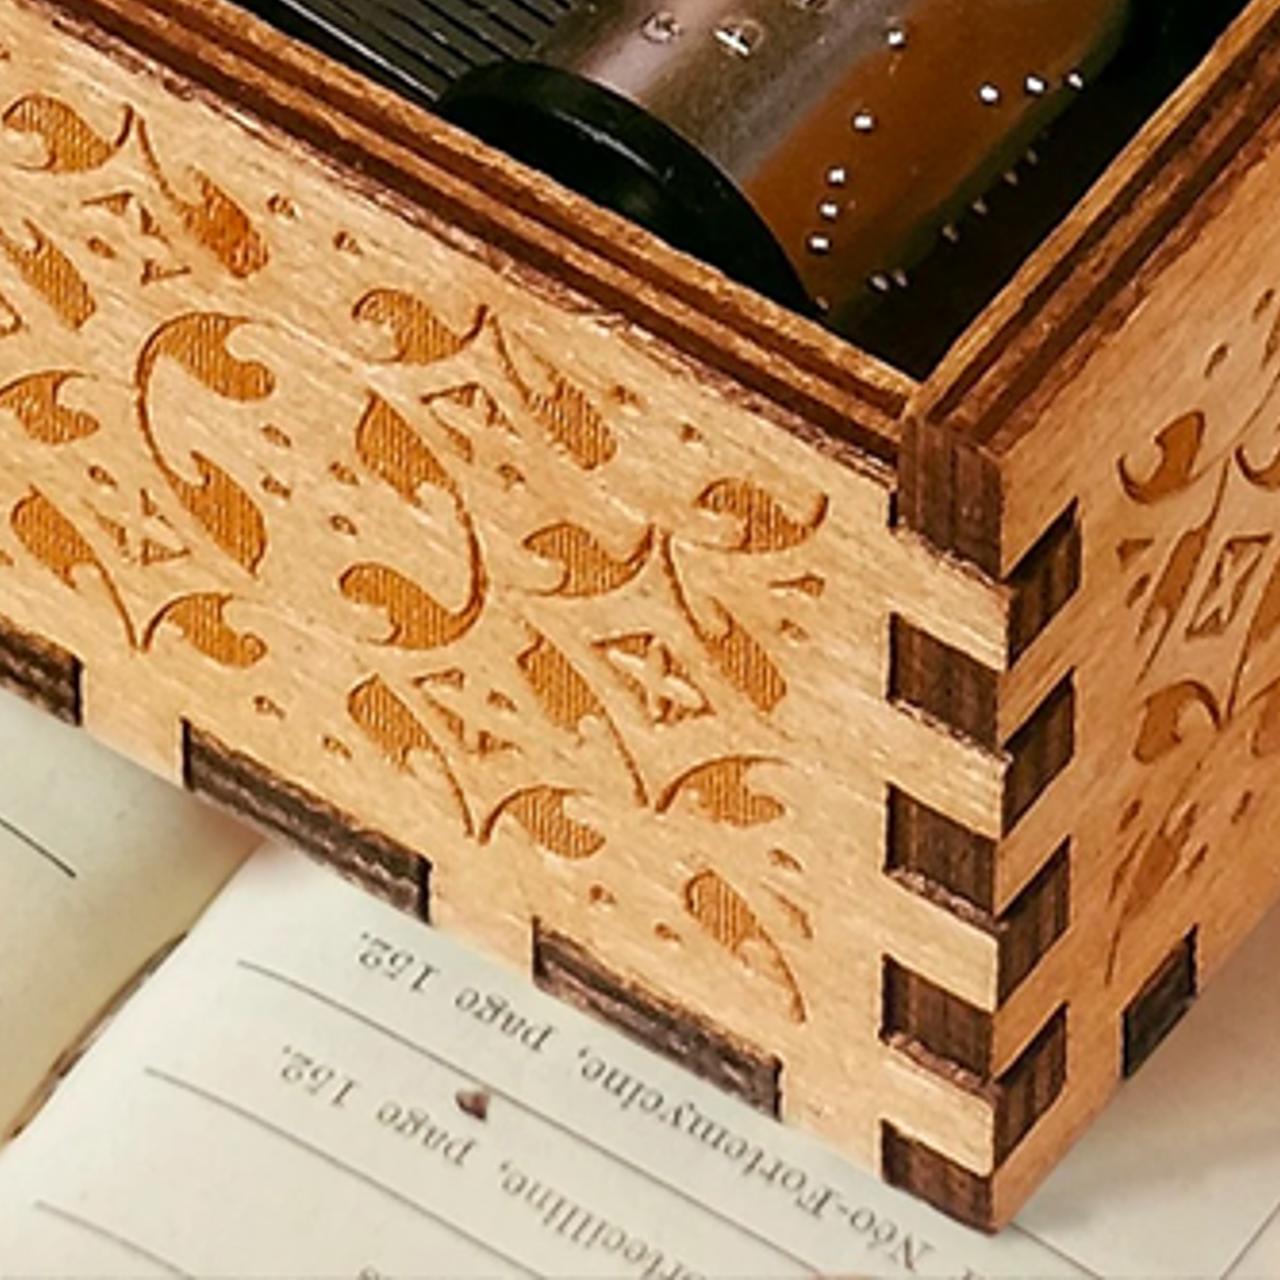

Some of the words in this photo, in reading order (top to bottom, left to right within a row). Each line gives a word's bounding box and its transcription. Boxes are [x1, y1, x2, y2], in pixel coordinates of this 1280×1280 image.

[355, 930, 440, 995] 152.
[455, 986, 555, 1053] page
[280, 1045, 357, 1109] 152.
[377, 1100, 476, 1169] page
[500, 1162, 695, 1280] rtecilline,
